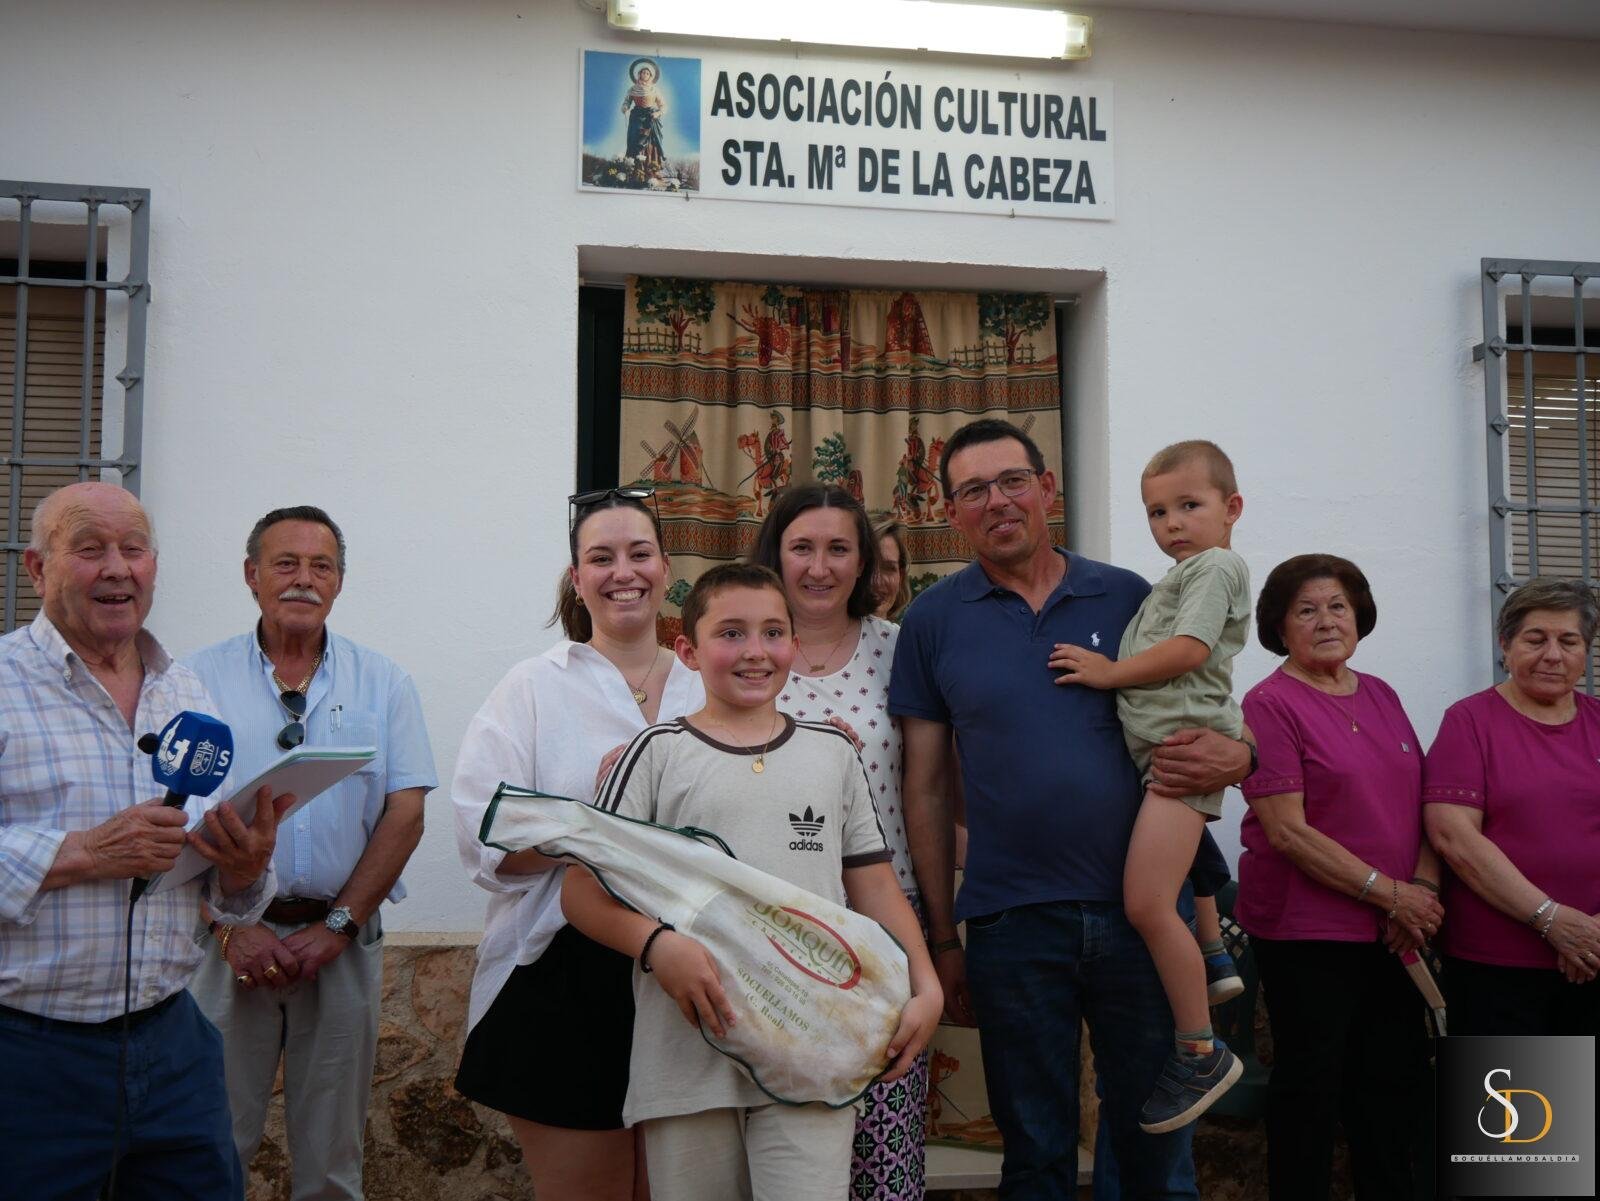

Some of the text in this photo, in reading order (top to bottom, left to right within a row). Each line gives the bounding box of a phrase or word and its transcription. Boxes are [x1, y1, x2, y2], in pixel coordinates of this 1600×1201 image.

[710, 70, 1107, 142] ASOCIACIÓN CULTURAL
[720, 138, 1097, 205] STA. Mª DE LA CABEZA
[789, 838, 824, 852] adidas
